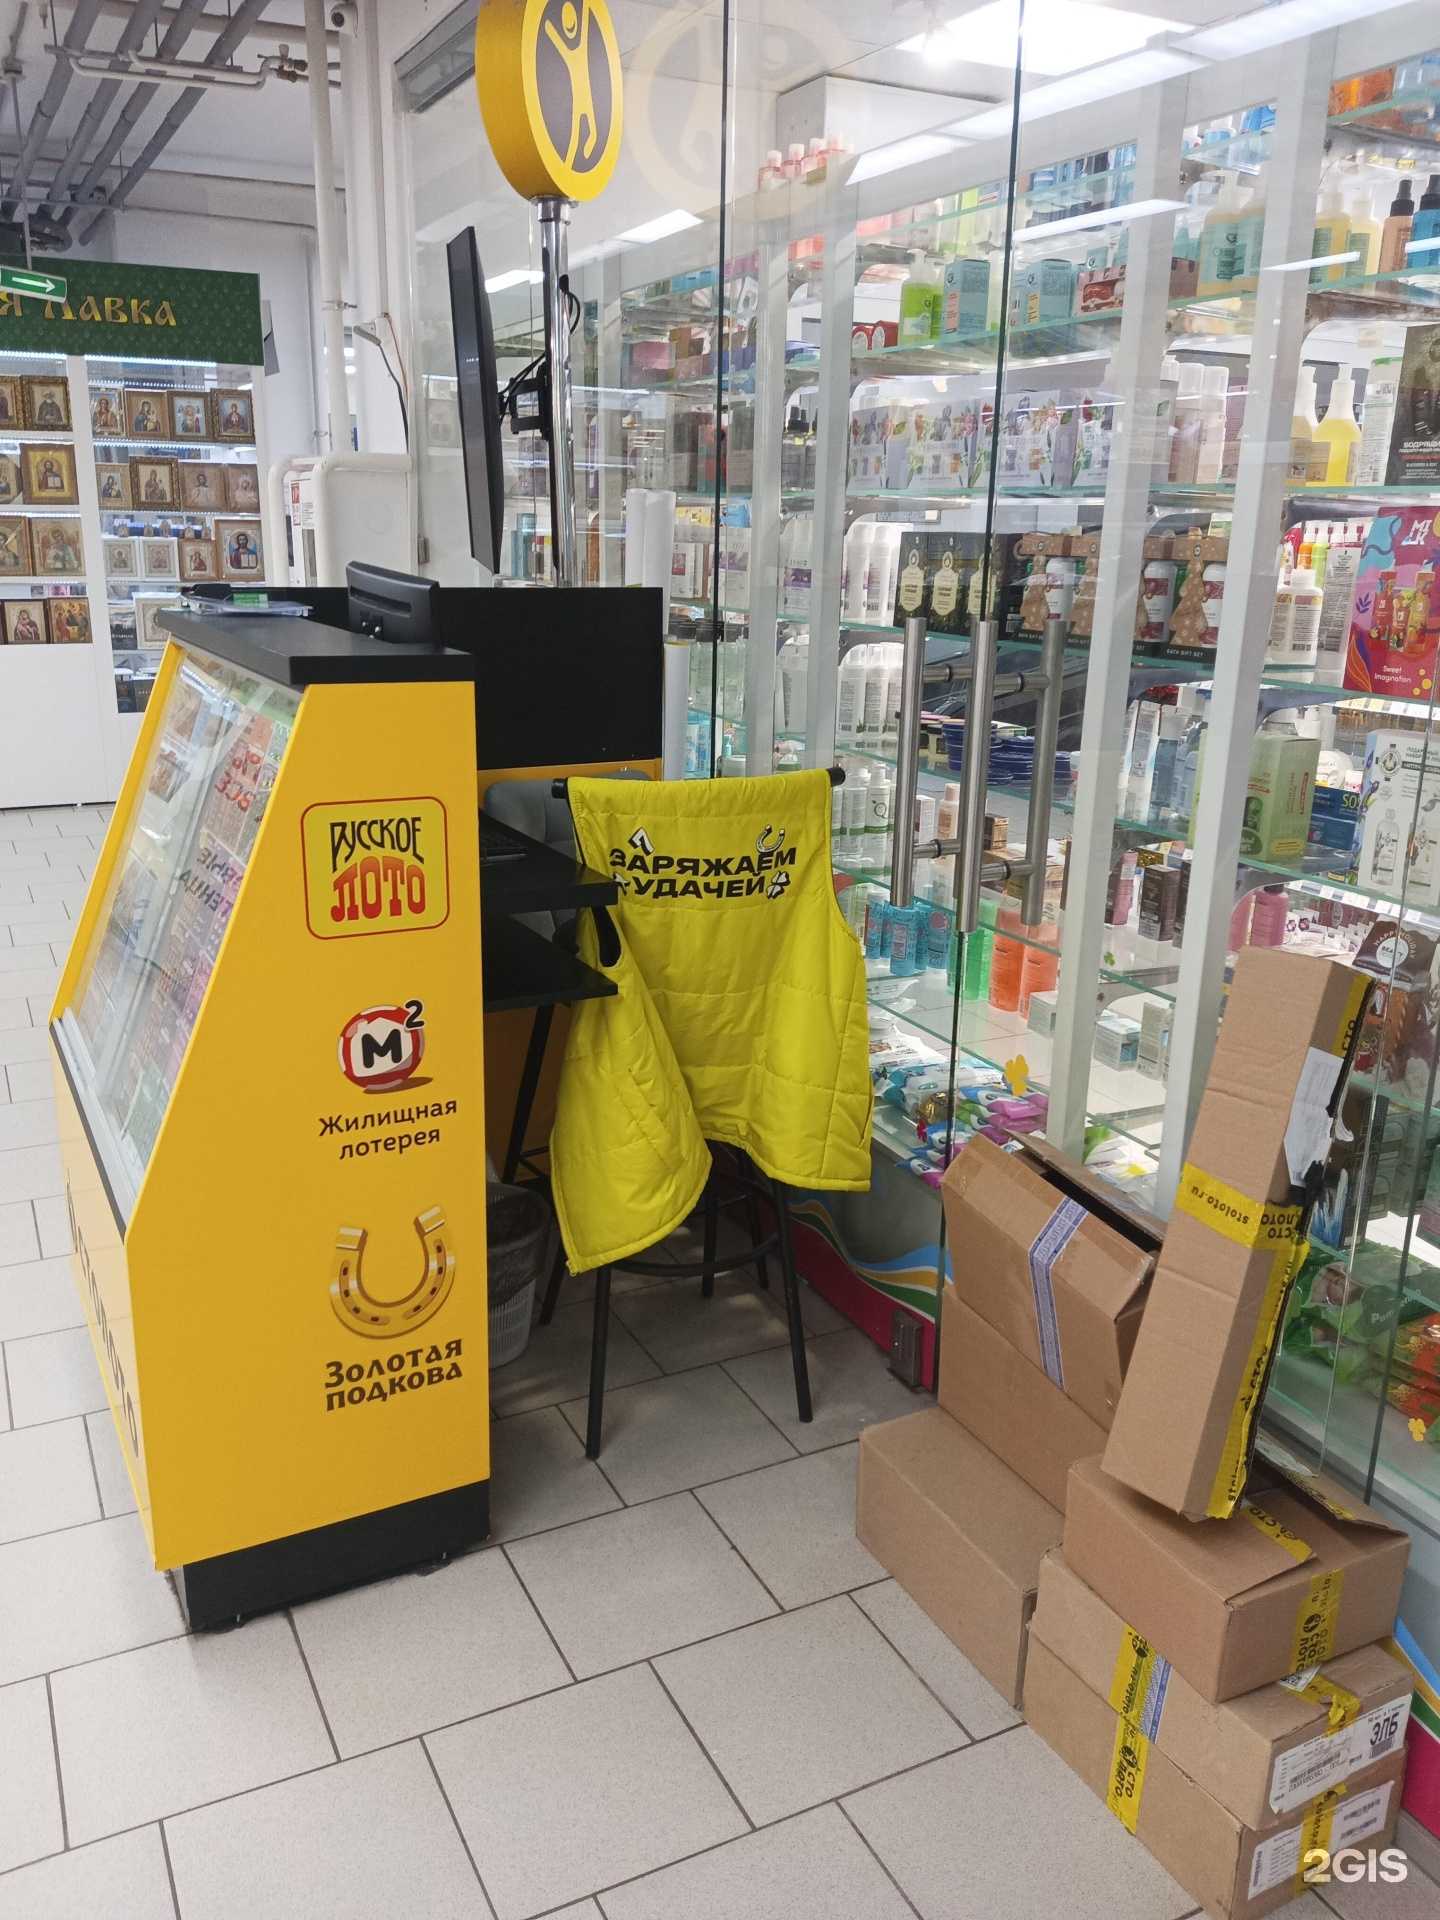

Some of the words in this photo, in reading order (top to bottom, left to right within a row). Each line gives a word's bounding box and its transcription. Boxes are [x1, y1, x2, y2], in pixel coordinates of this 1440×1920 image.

[329, 816, 425, 874] РУССКОЕ
[609, 847, 797, 877] ЗАРЯЖАЕМ
[330, 855, 426, 923] ЛОТО
[632, 871, 766, 900] УДАЧЕЙ
[319, 1100, 458, 1137] Жилищная
[339, 1128, 441, 1160] лотерея
[1191, 1185, 1250, 1225] stoloto.ru
